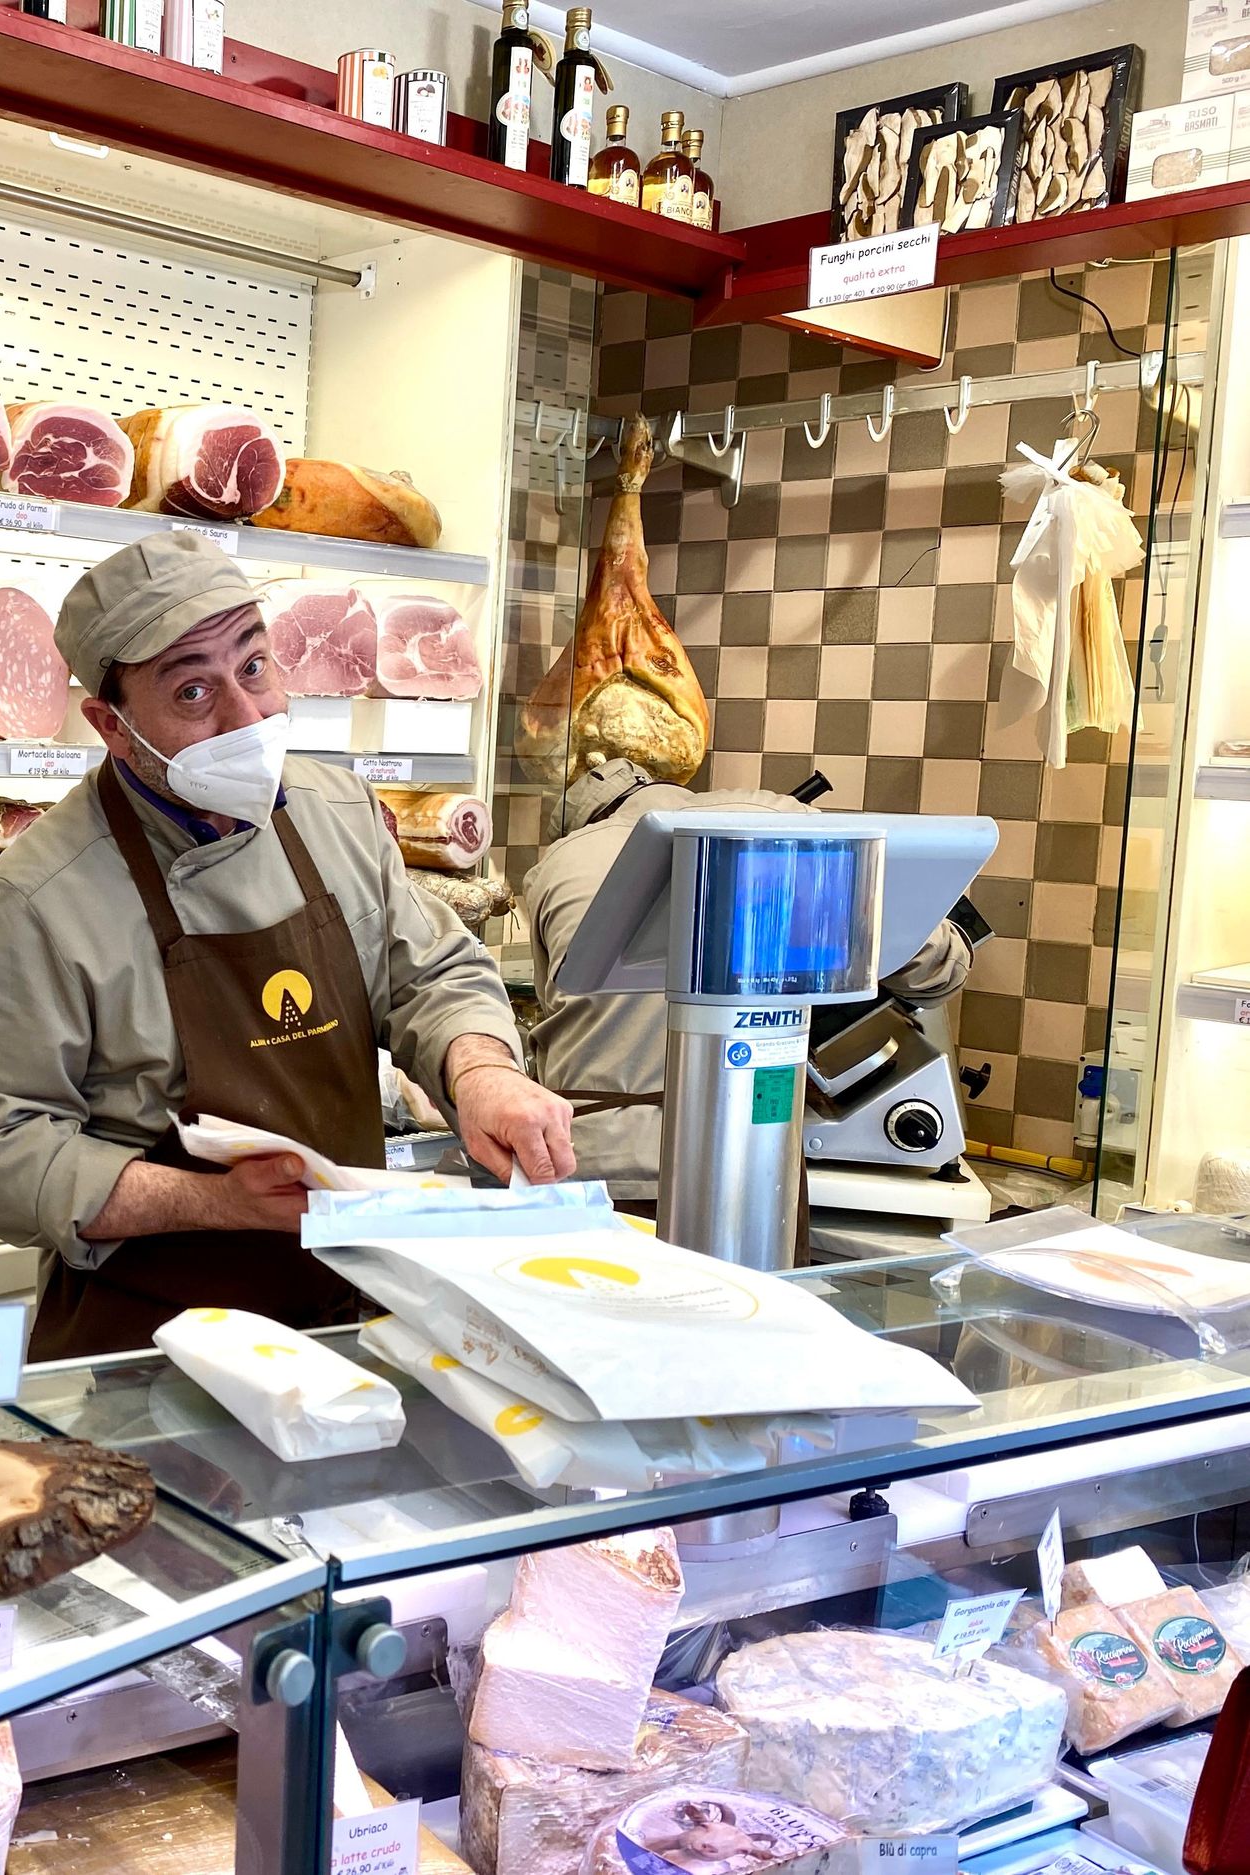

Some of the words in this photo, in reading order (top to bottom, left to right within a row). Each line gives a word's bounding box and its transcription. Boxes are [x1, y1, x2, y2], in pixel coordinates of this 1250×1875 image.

[1188, 106, 1217, 119] RISO
[1184, 116, 1218, 132] BASMATI
[1117, 107, 1134, 160] PORCINI
[820, 249, 855, 265] Funghi
[858, 243, 894, 261] porcini
[897, 233, 931, 250] secchi
[843, 269, 876, 285] qualità
[878, 264, 906, 277] extra
[18, 502, 24, 510] di
[27, 503, 47, 513] Parma
[15, 512, 27, 520] dop
[210, 530, 228, 538] Sauris
[379, 759, 402, 767] Nostrano
[734, 1009, 803, 1028] ZENITH
[271, 1035, 291, 1045] CASA
[292, 1031, 307, 1040] DEL
[731, 1047, 749, 1061] GG
[349, 1822, 388, 1839] Ubriaco
[341, 1851, 368, 1865] latte
[371, 1841, 401, 1857] crudo
[879, 1843, 895, 1857] Blù
[898, 1843, 907, 1857] di
[909, 1845, 938, 1860] capra
